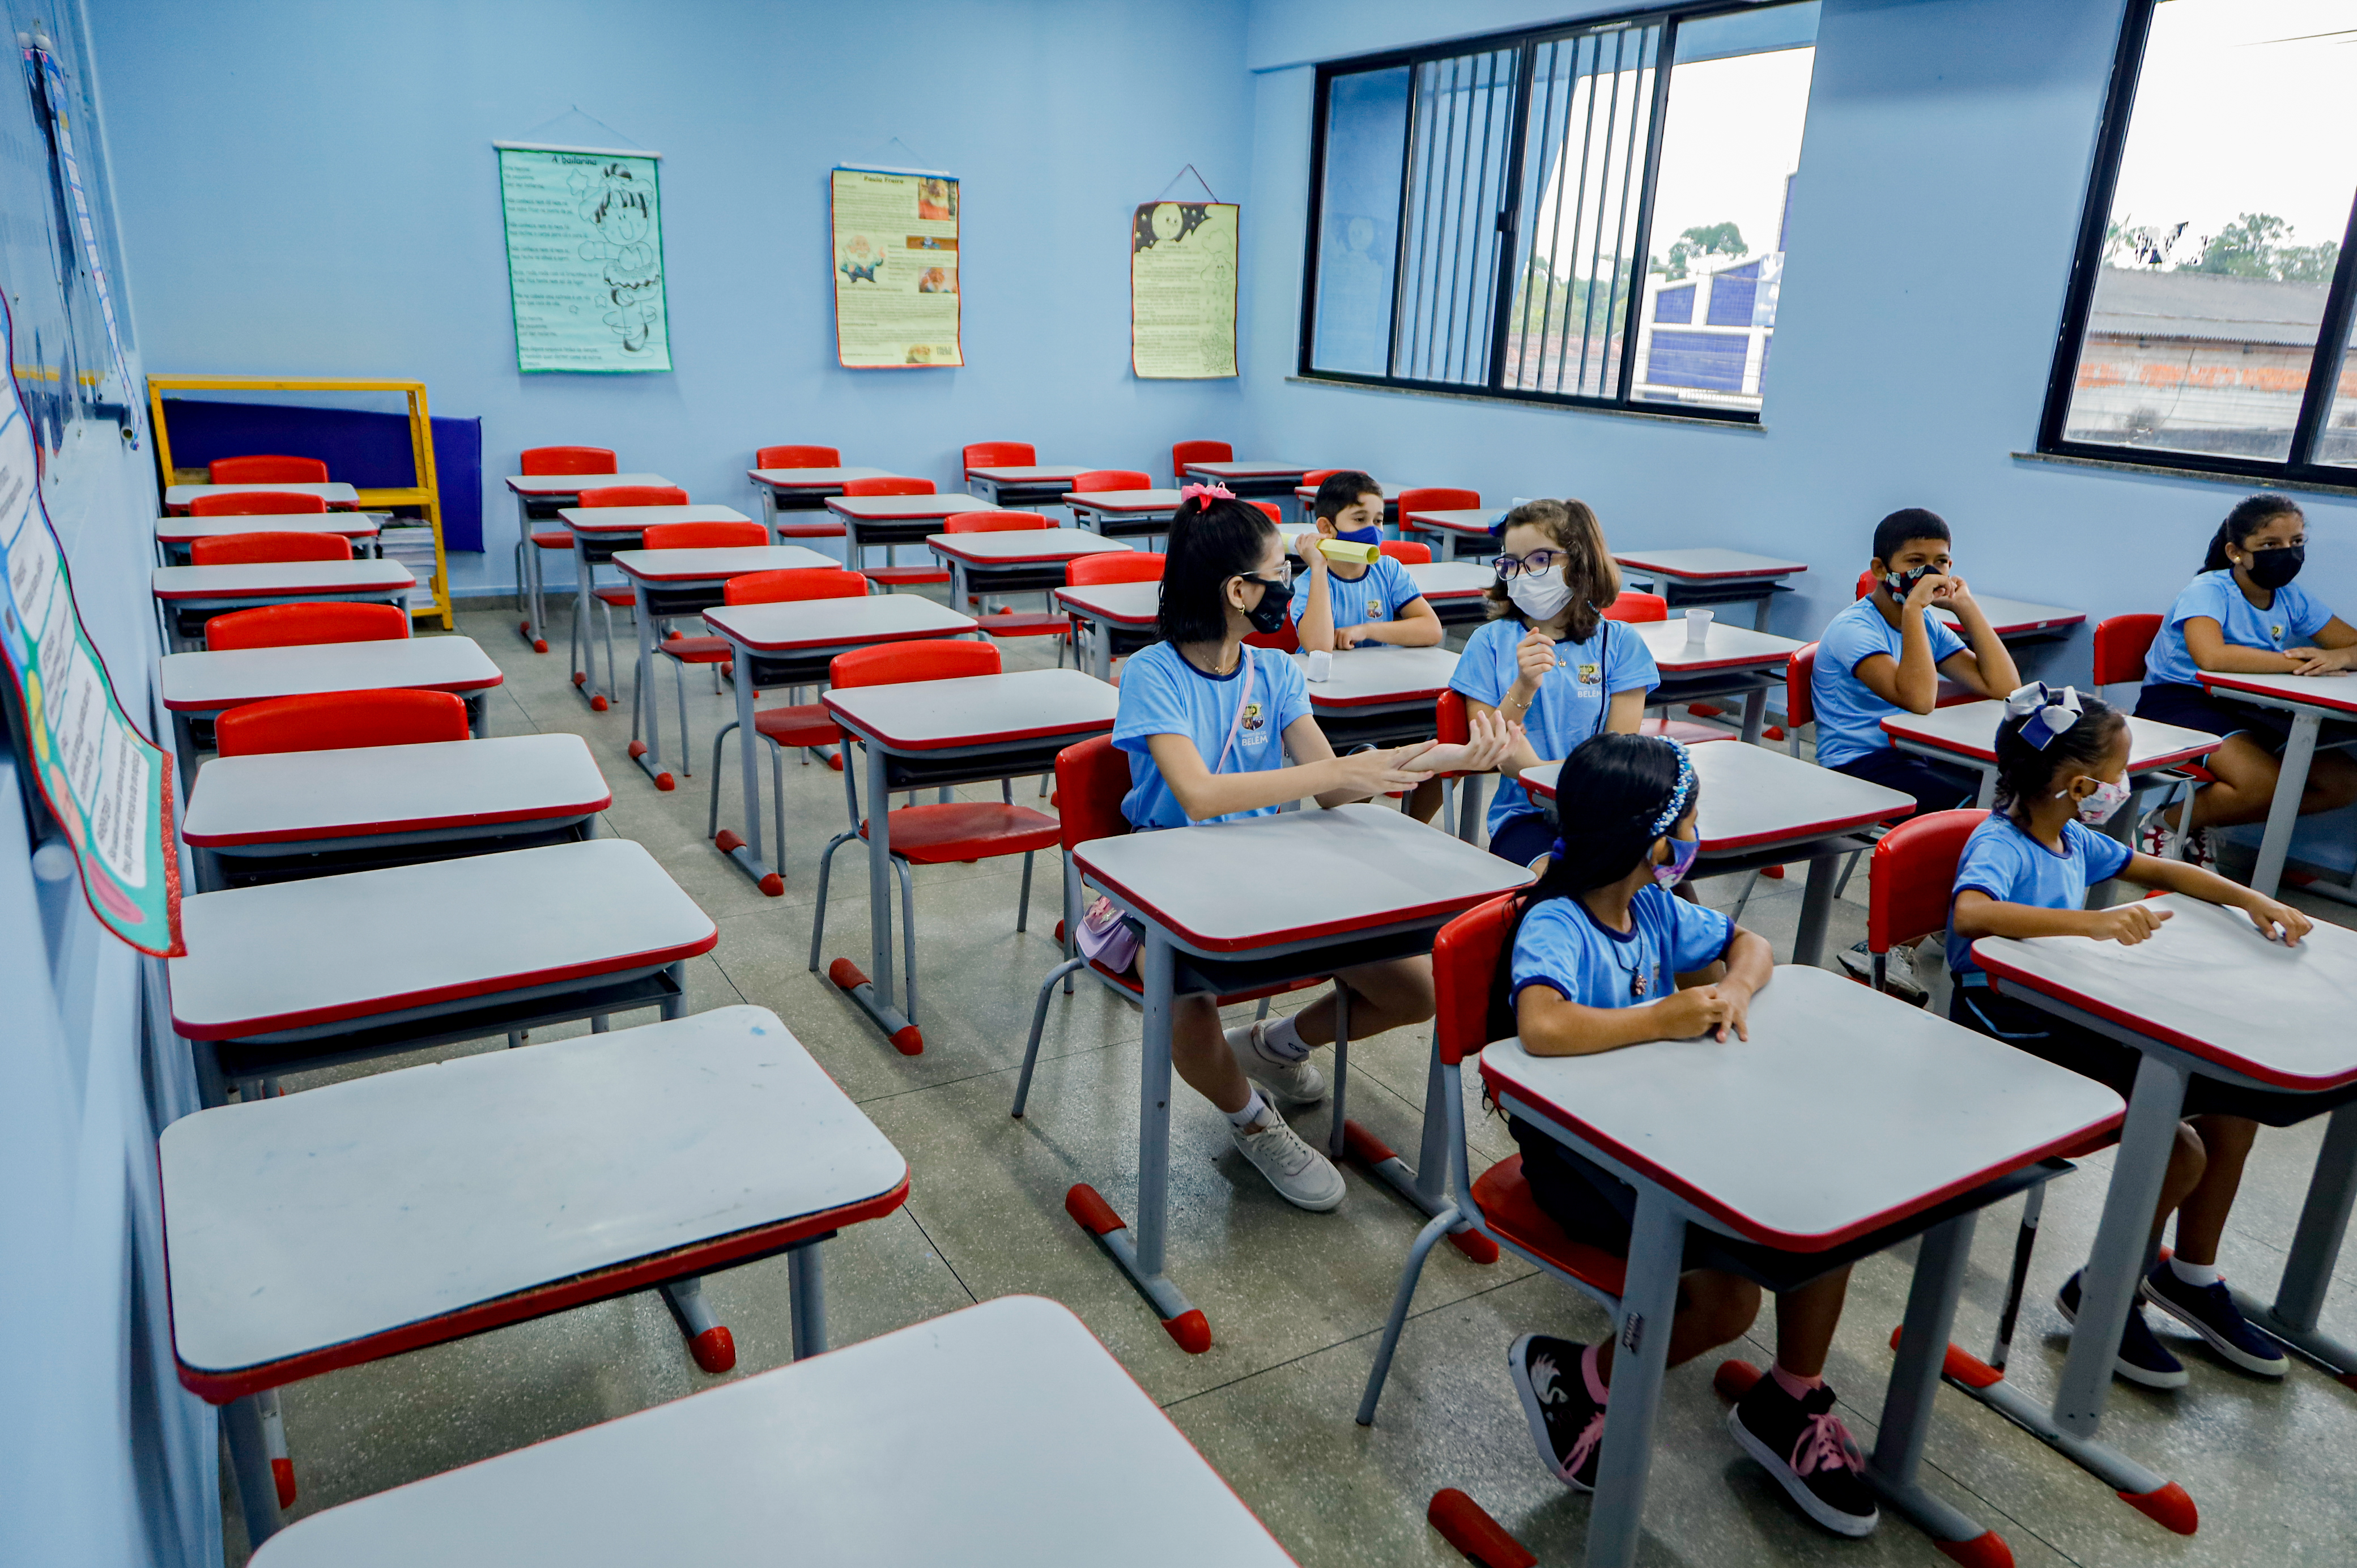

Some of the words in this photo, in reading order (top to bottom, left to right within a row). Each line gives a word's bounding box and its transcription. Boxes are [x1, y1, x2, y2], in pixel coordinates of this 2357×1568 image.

[551, 155, 558, 163] A
[561, 155, 597, 165] bailarina
[1241, 735, 1268, 745] BELÉM
